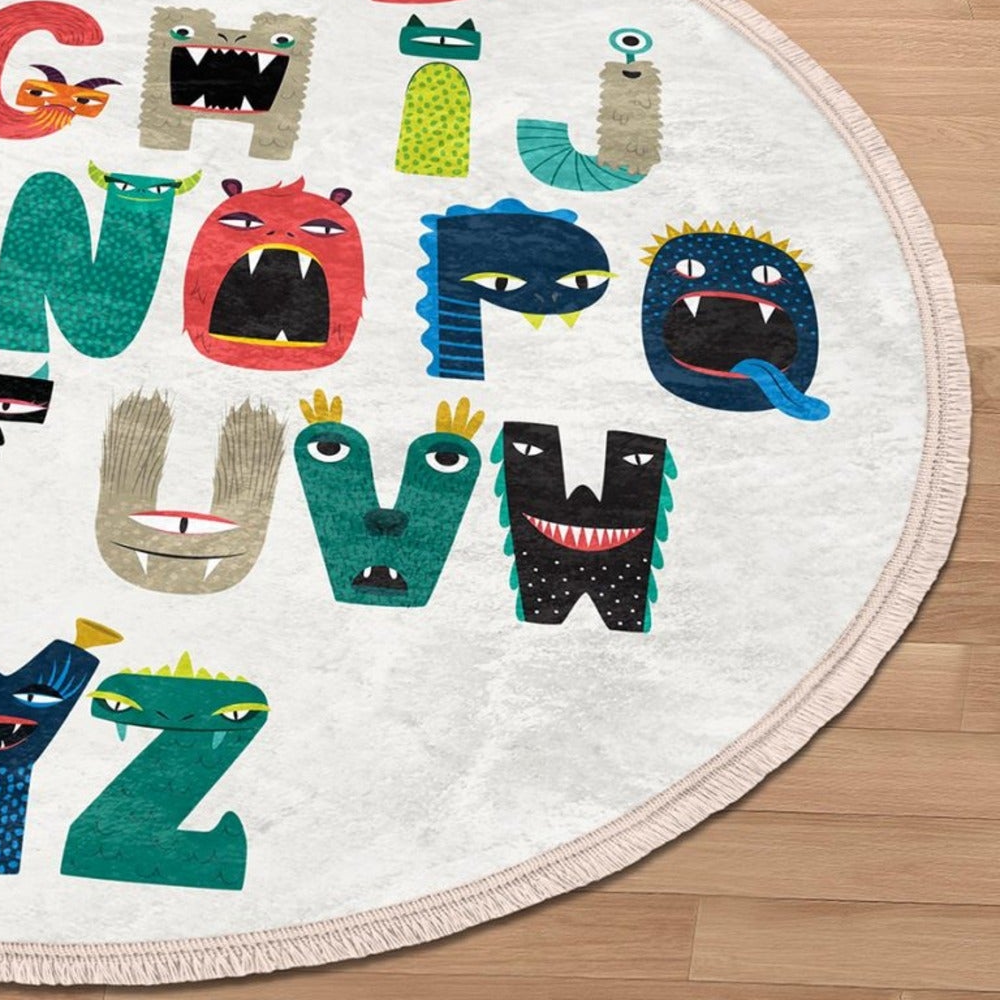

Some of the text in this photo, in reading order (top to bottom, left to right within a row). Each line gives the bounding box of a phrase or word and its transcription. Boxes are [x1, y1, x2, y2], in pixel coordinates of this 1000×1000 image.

[138, 5, 318, 161] H
[516, 27, 664, 193] J
[181, 176, 368, 371] O
[415, 198, 617, 382] P
[640, 220, 831, 423] Q
[94, 387, 288, 596] U
[293, 388, 483, 608] V
[490, 420, 677, 634] W
[60, 651, 270, 891] Z
